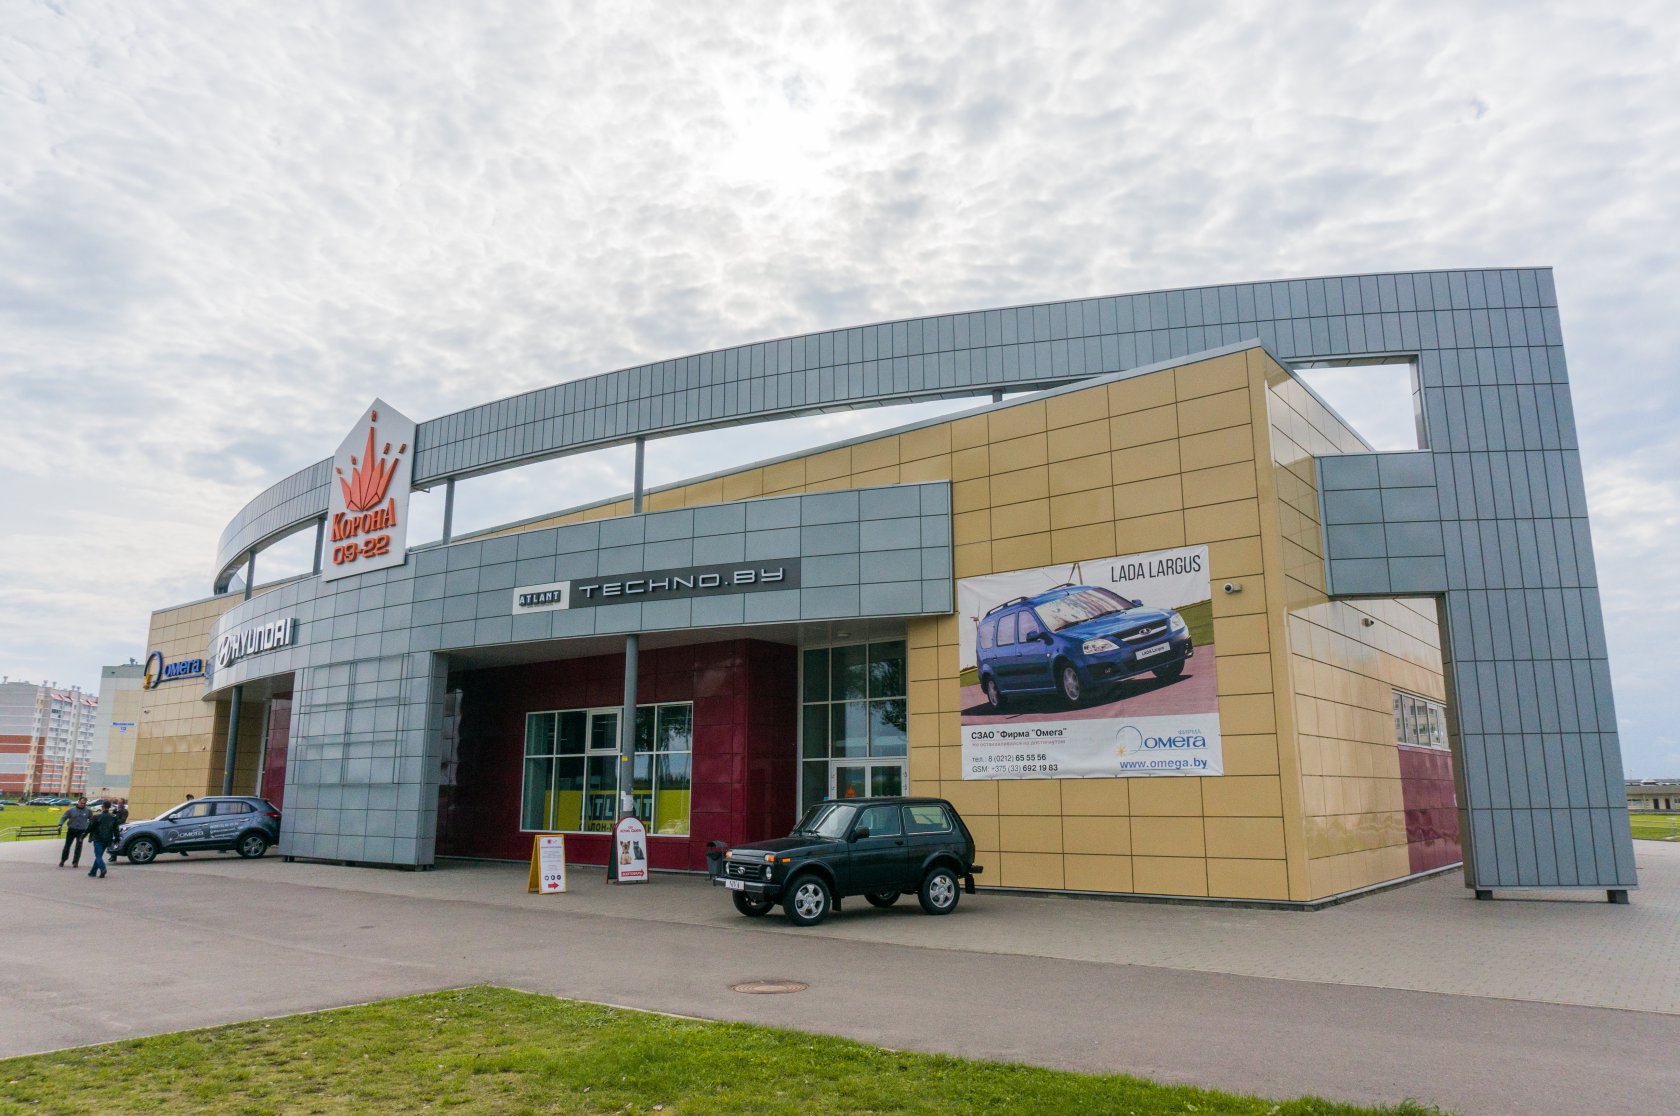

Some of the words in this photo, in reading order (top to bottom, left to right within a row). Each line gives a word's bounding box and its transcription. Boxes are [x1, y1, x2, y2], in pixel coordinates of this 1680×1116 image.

[333, 535, 391, 565] 09-22
[1111, 562, 1146, 583] LADA
[1148, 554, 1201, 578] LARGUS
[578, 567, 783, 598] TECHNO.BY
[519, 591, 560, 604] ATLANT
[231, 617, 294, 660] HYUNDAI
[971, 731, 995, 740] СЗАО
[1144, 735, 1206, 749] омега
[993, 754, 1014, 763] (0212)
[1037, 753, 1047, 761] 56
[1119, 757, 1208, 770] www.omega.by
